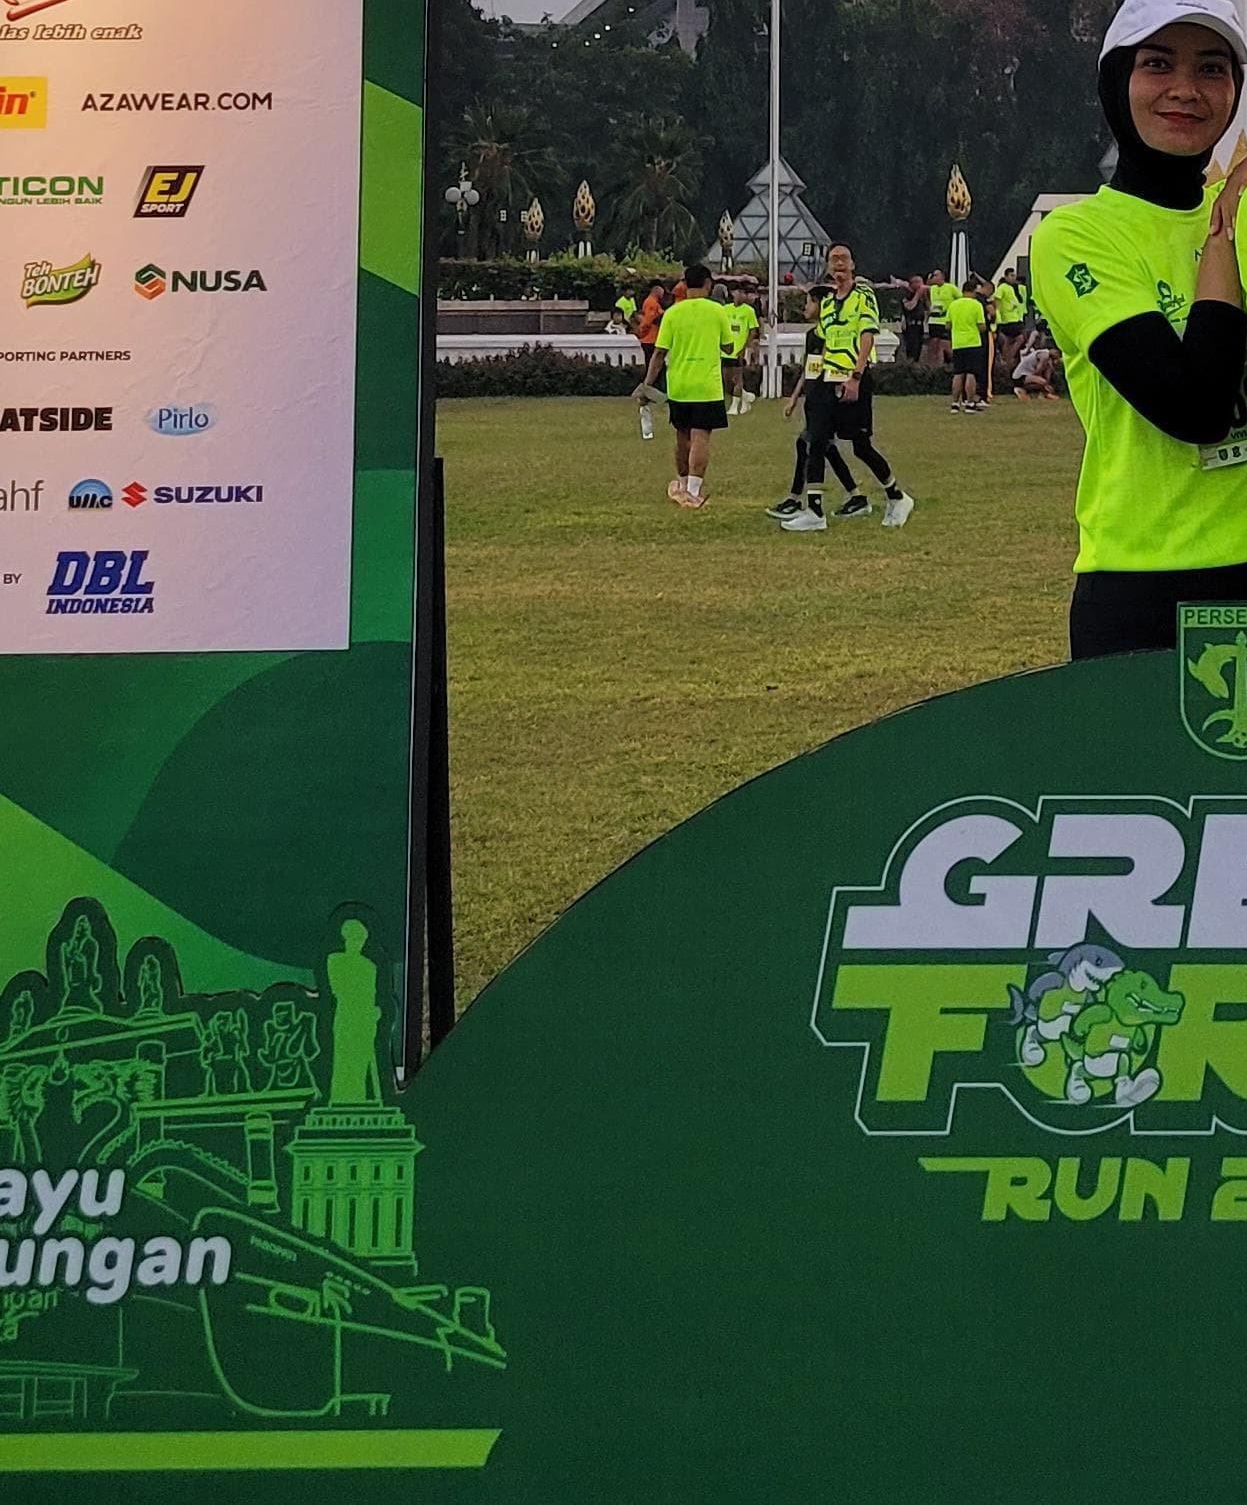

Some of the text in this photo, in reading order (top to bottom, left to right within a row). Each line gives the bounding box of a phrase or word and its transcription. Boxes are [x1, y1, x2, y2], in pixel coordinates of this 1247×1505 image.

[33, 24, 86, 40] lebih
[91, 24, 142, 40] enak
[81, 92, 273, 111] AZAWEAR.COM
[0, 176, 104, 196] TICON
[144, 172, 197, 203] EJ
[140, 203, 184, 214] SPORT
[24, 261, 52, 278] Teh
[21, 262, 101, 299] BONTEH
[171, 269, 268, 292] NUSA
[59, 350, 131, 361] PARTNERS
[0, 407, 113, 432] ATSIDE
[158, 407, 209, 430] Pirlo
[153, 485, 264, 504] SUZUKI
[3, 573, 22, 585] BY
[46, 550, 155, 596] DBL
[46, 597, 154, 614] INDONESIA
[918, 1156, 1191, 1221] RUN
